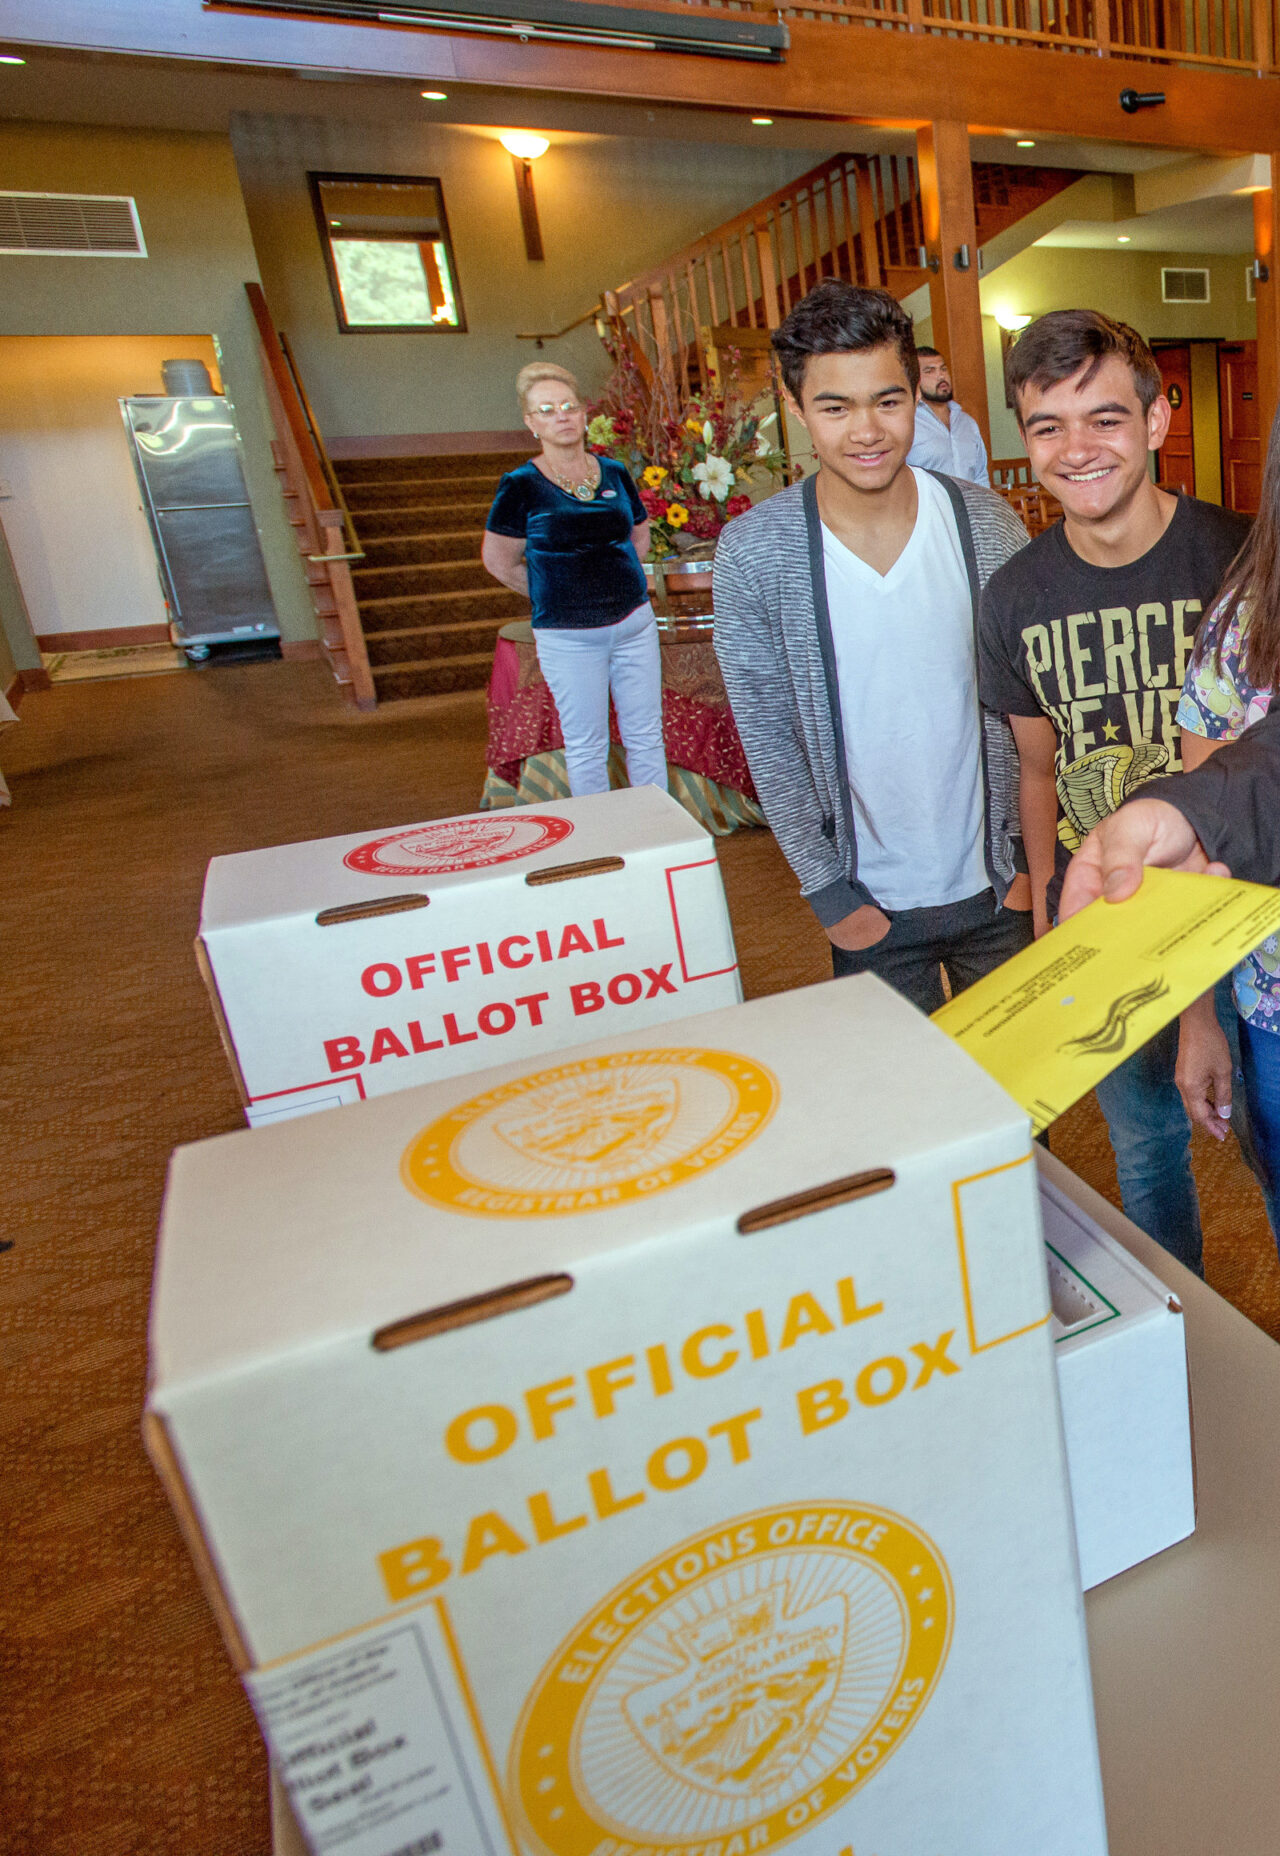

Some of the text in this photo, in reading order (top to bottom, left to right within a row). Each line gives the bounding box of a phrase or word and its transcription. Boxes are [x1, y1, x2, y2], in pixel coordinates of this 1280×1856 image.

[475, 856, 500, 866] OF
[323, 961, 679, 1073] BALLOT BOX
[360, 918, 625, 998] OFFICIAL
[636, 1171, 675, 1192] OF
[688, 1109, 763, 1169] VOTERS
[444, 1276, 884, 1466] OFFICIAL
[378, 1330, 961, 1604] BALLOT BOX
[558, 1512, 889, 1685] ELECTIONS OFFICE
[786, 1791, 831, 1828] OF
[835, 1677, 925, 1783] VOTERS
